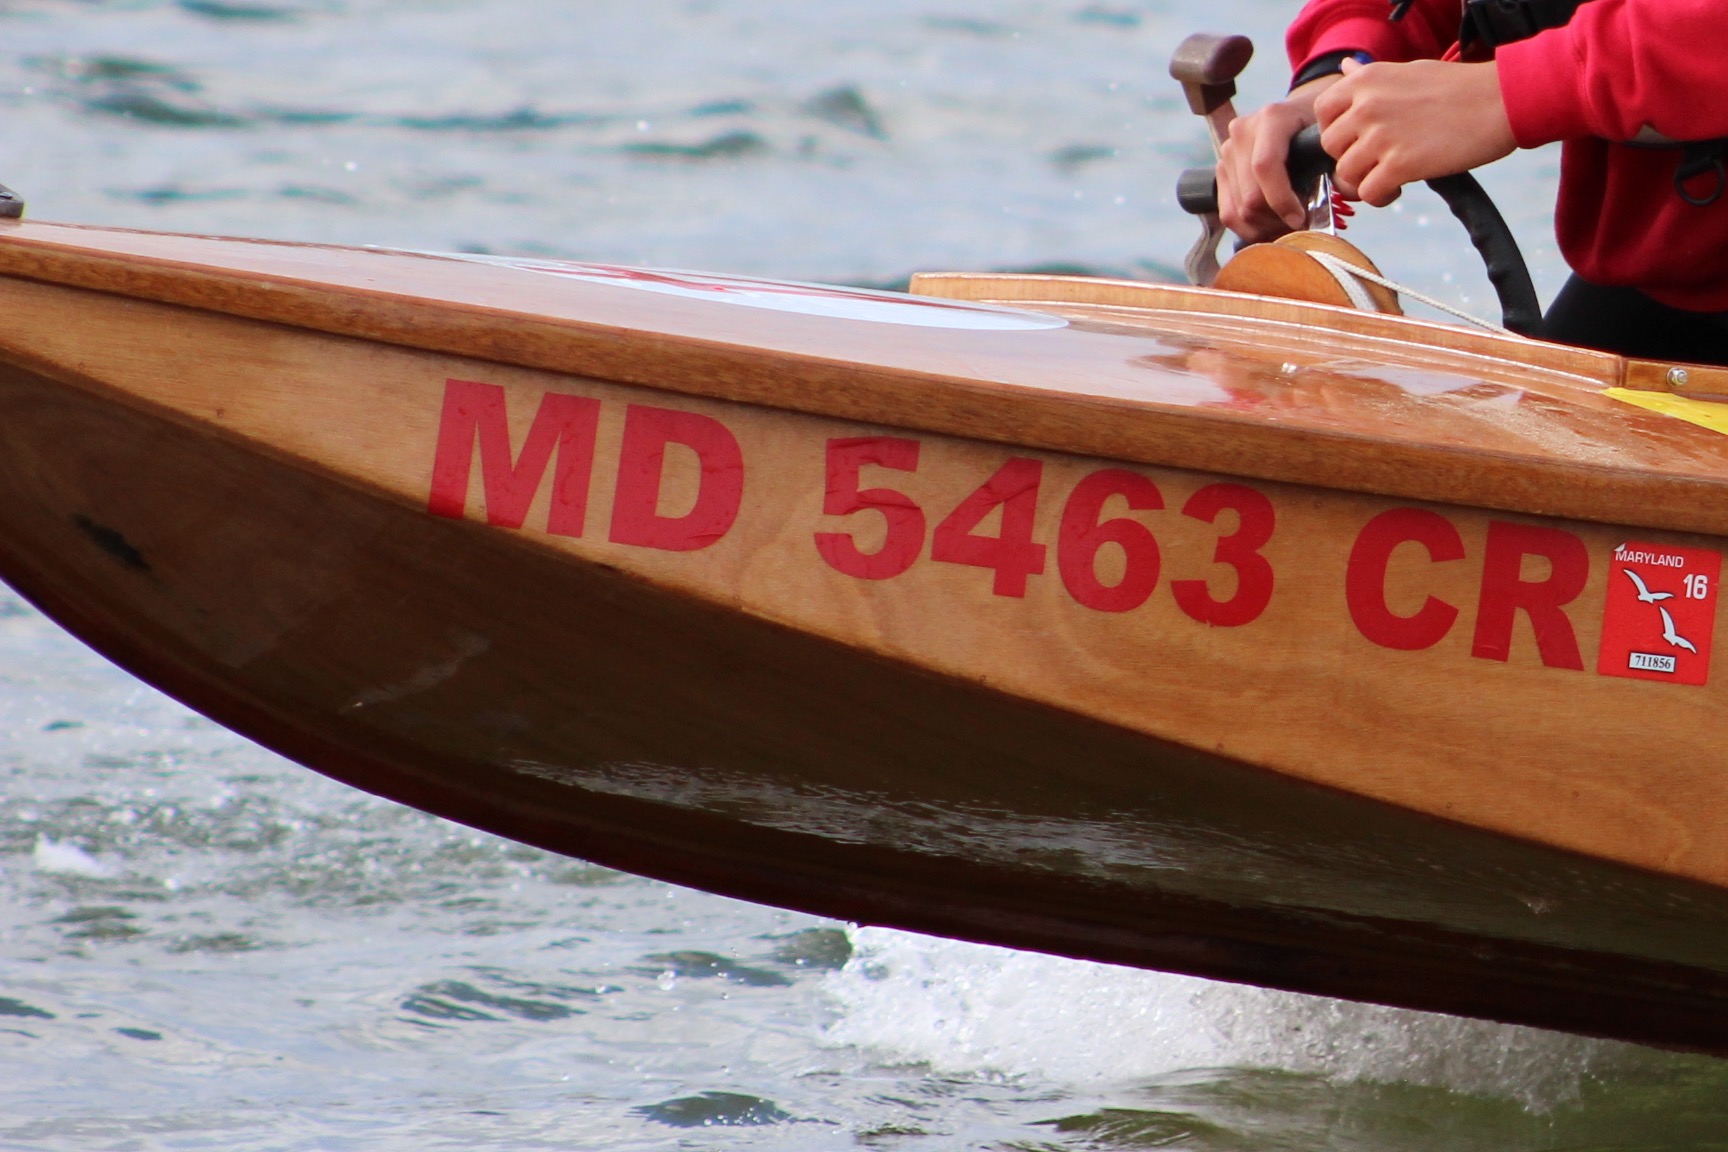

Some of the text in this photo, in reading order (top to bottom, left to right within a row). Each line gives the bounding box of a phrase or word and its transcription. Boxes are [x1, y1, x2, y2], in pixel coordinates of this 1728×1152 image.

[426, 378, 1590, 671] MD 5463 CR
[1615, 551, 1684, 568] MARYLAND
[1683, 573, 1708, 600] 16
[1635, 655, 1671, 669] 711856
